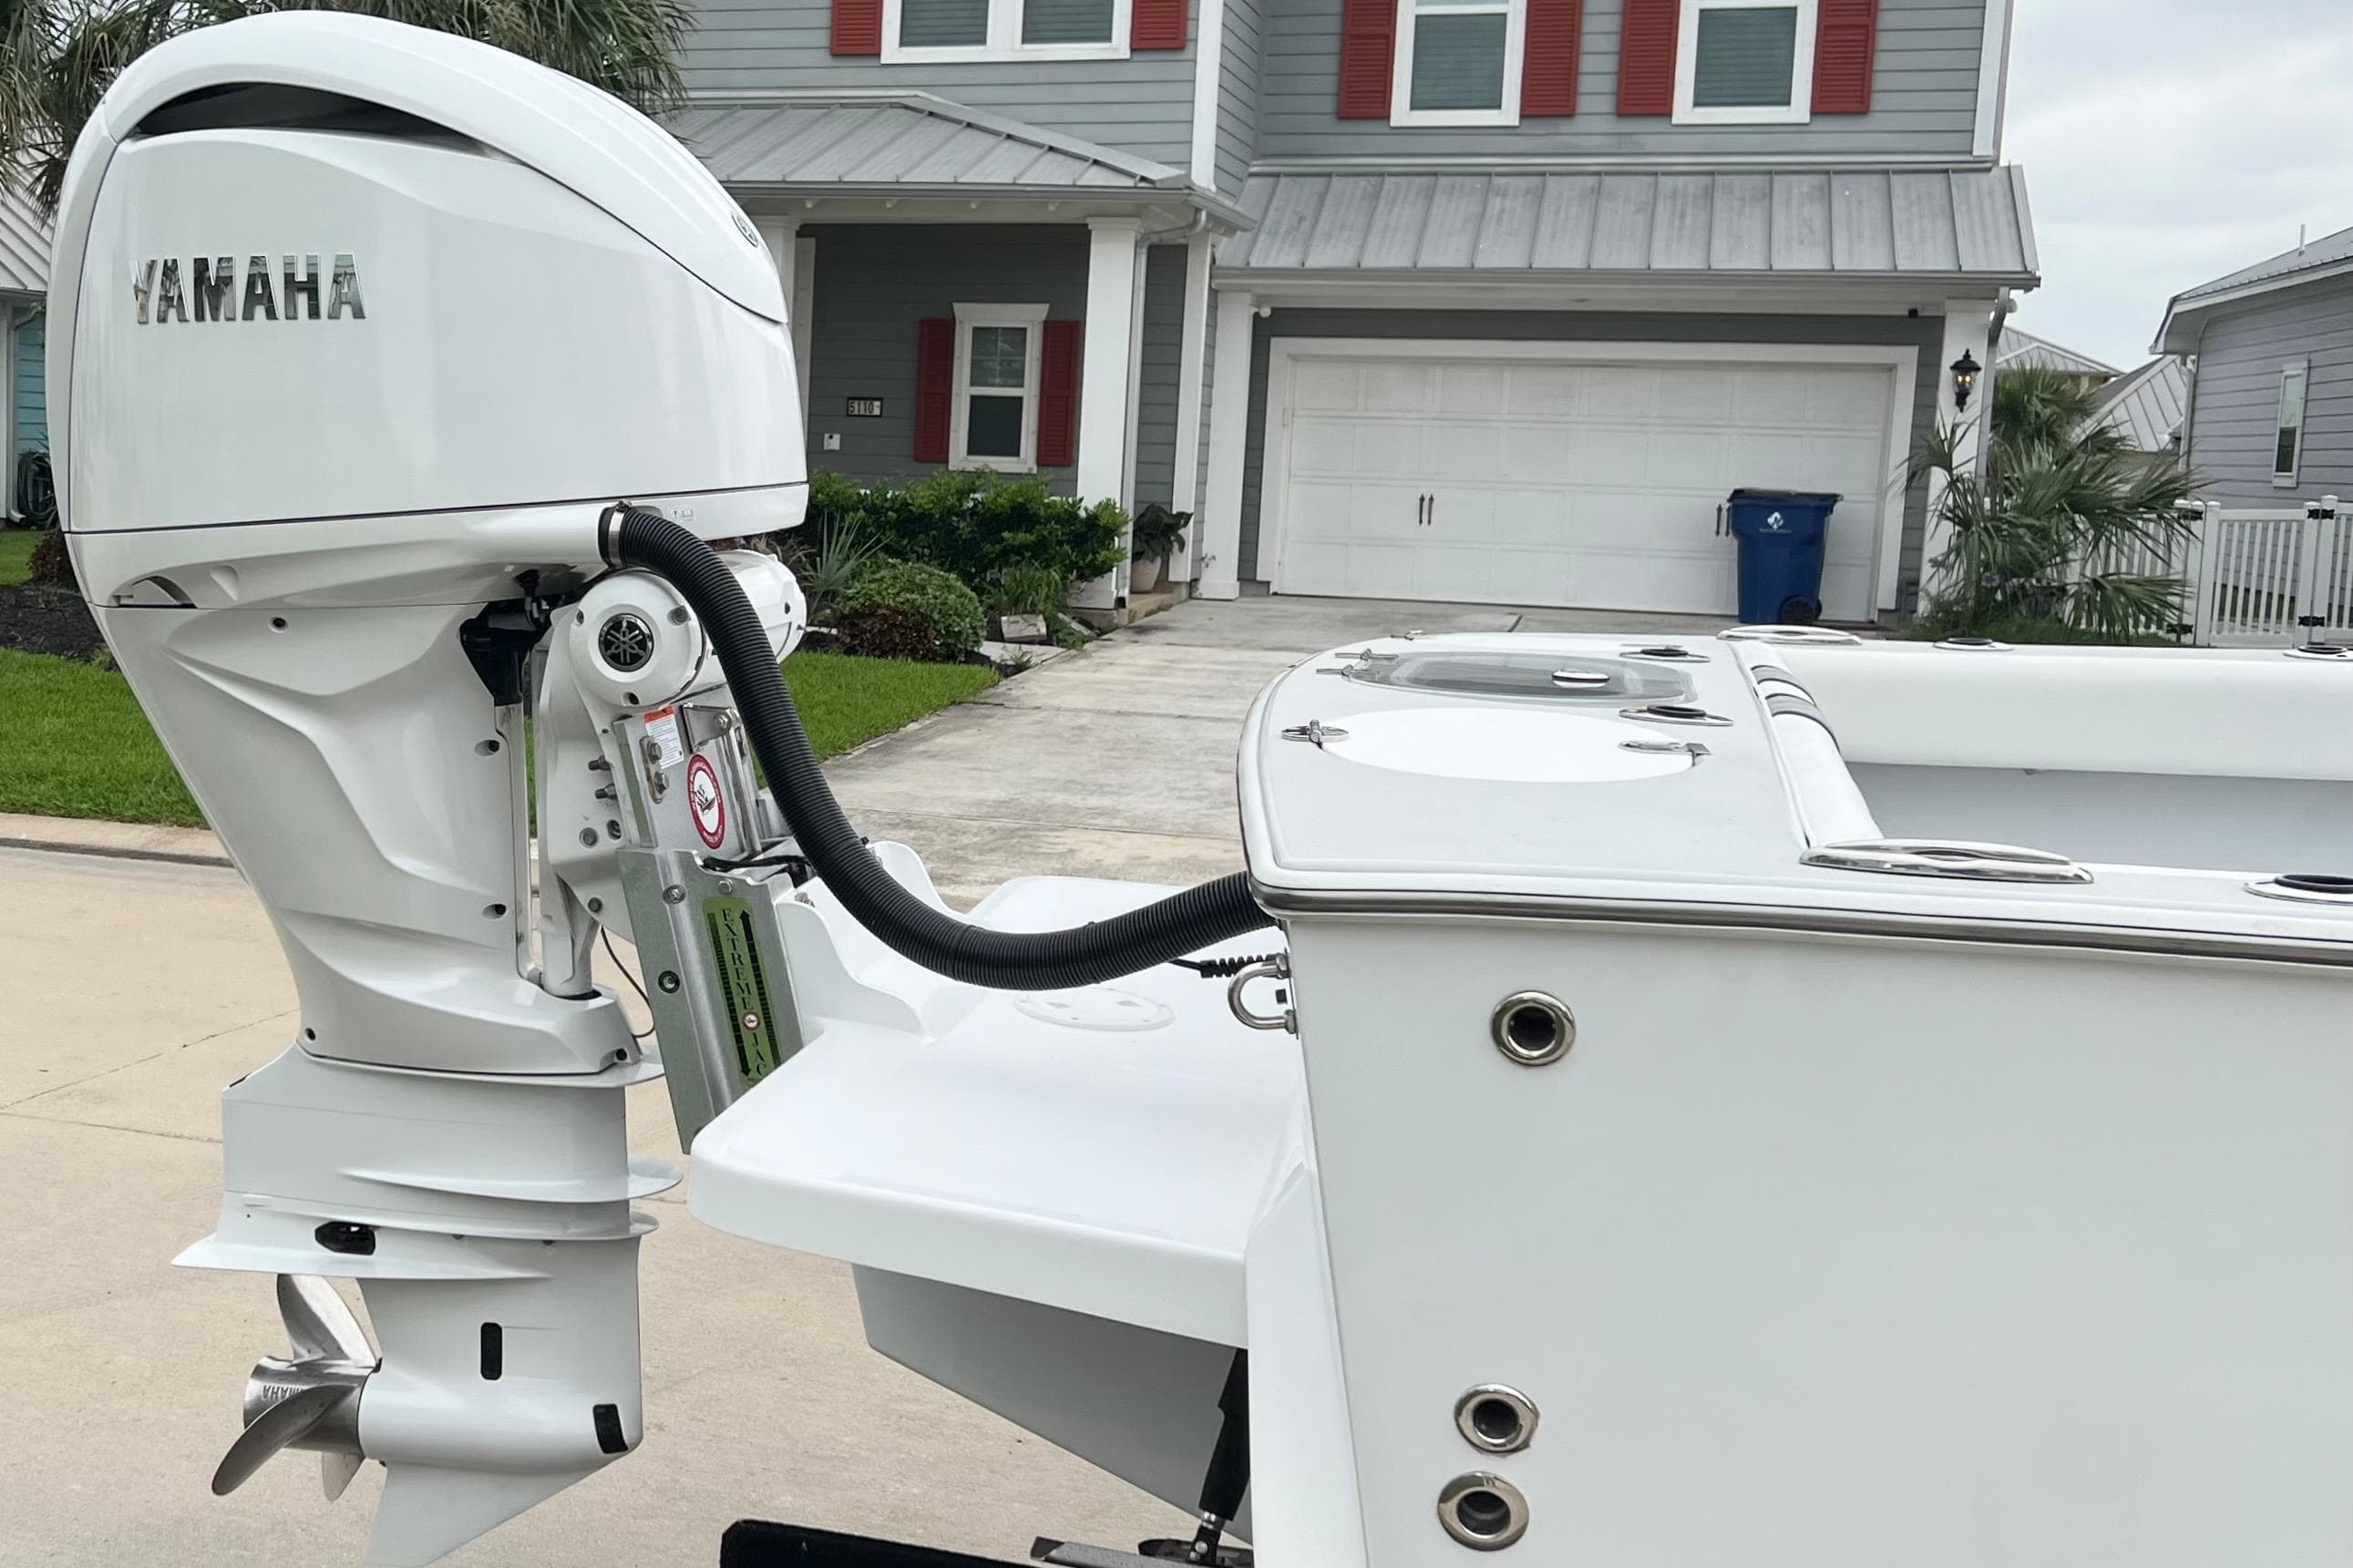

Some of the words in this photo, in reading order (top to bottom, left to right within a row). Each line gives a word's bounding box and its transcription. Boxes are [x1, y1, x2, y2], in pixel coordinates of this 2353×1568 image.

[130, 253, 366, 324] YAMAHA
[849, 401, 874, 415] 5110
[723, 908, 755, 1010] EXTREME
